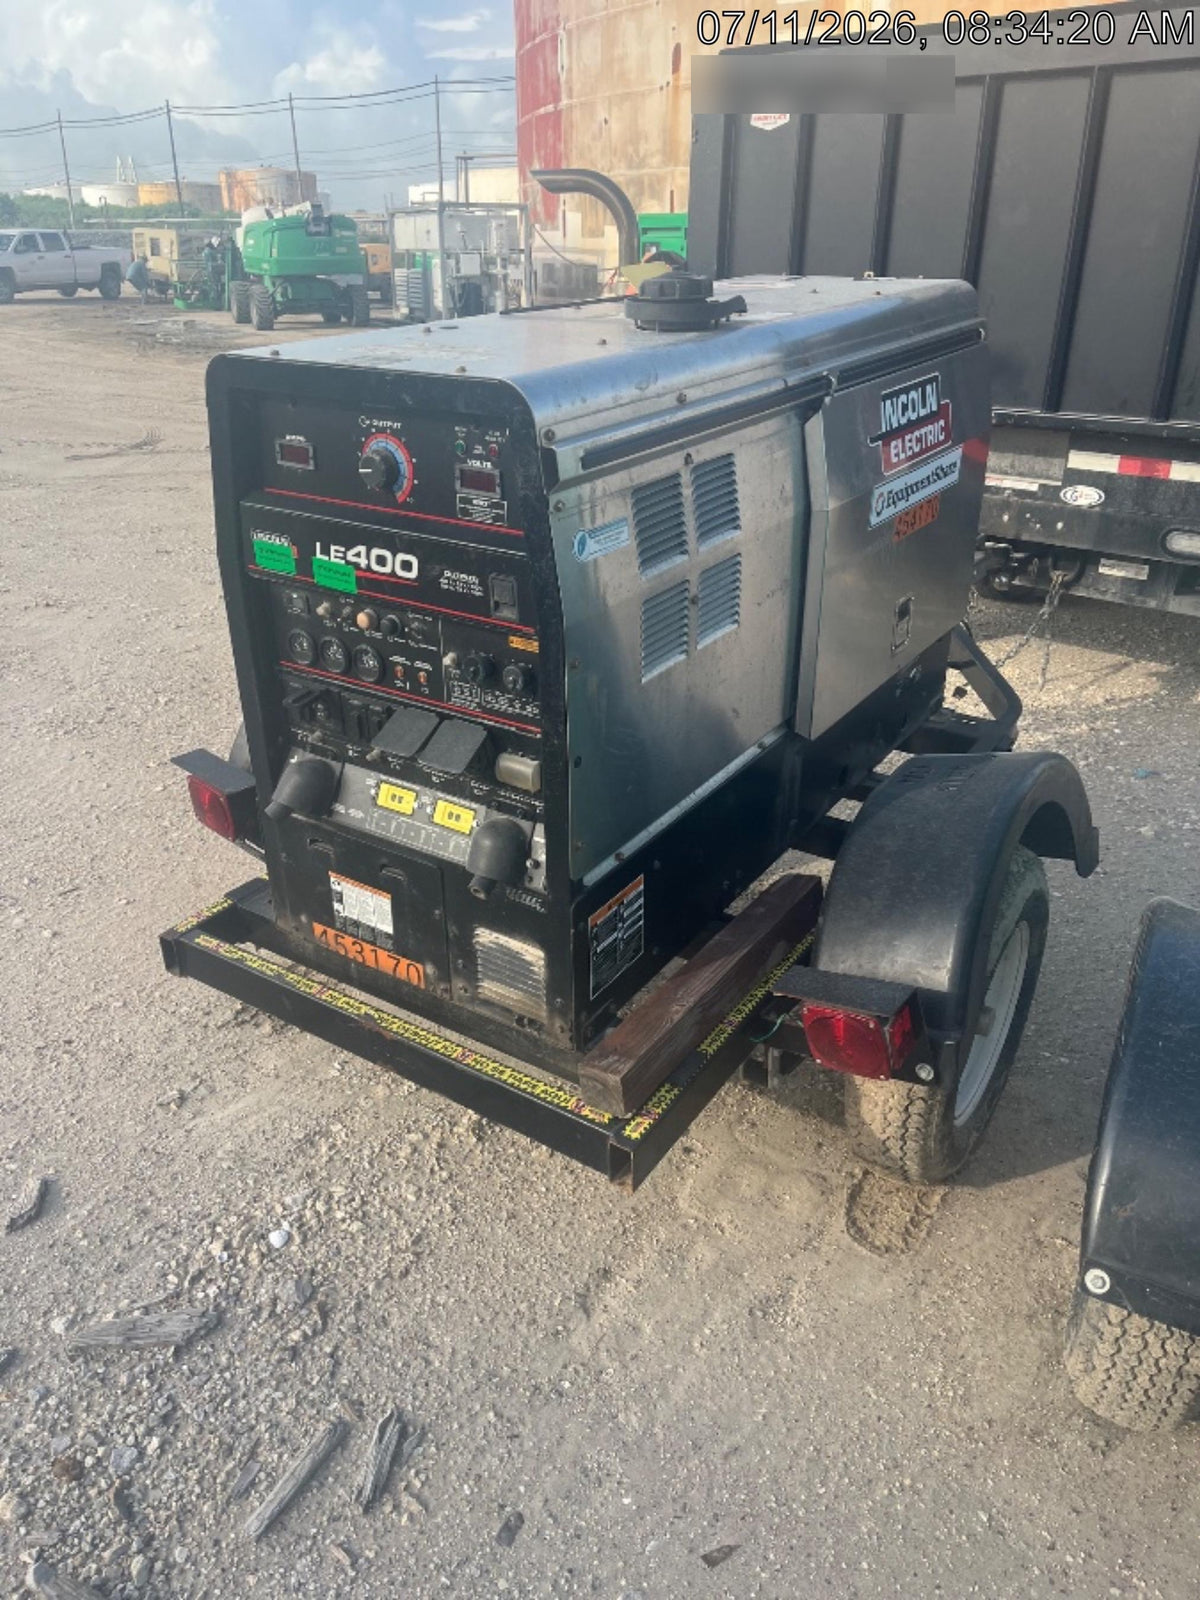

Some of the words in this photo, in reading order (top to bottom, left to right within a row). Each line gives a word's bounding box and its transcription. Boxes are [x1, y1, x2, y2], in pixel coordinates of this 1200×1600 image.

[889, 418, 946, 465] ELECTRIC
[315, 541, 420, 580] LE400
[318, 929, 423, 987] 453170
